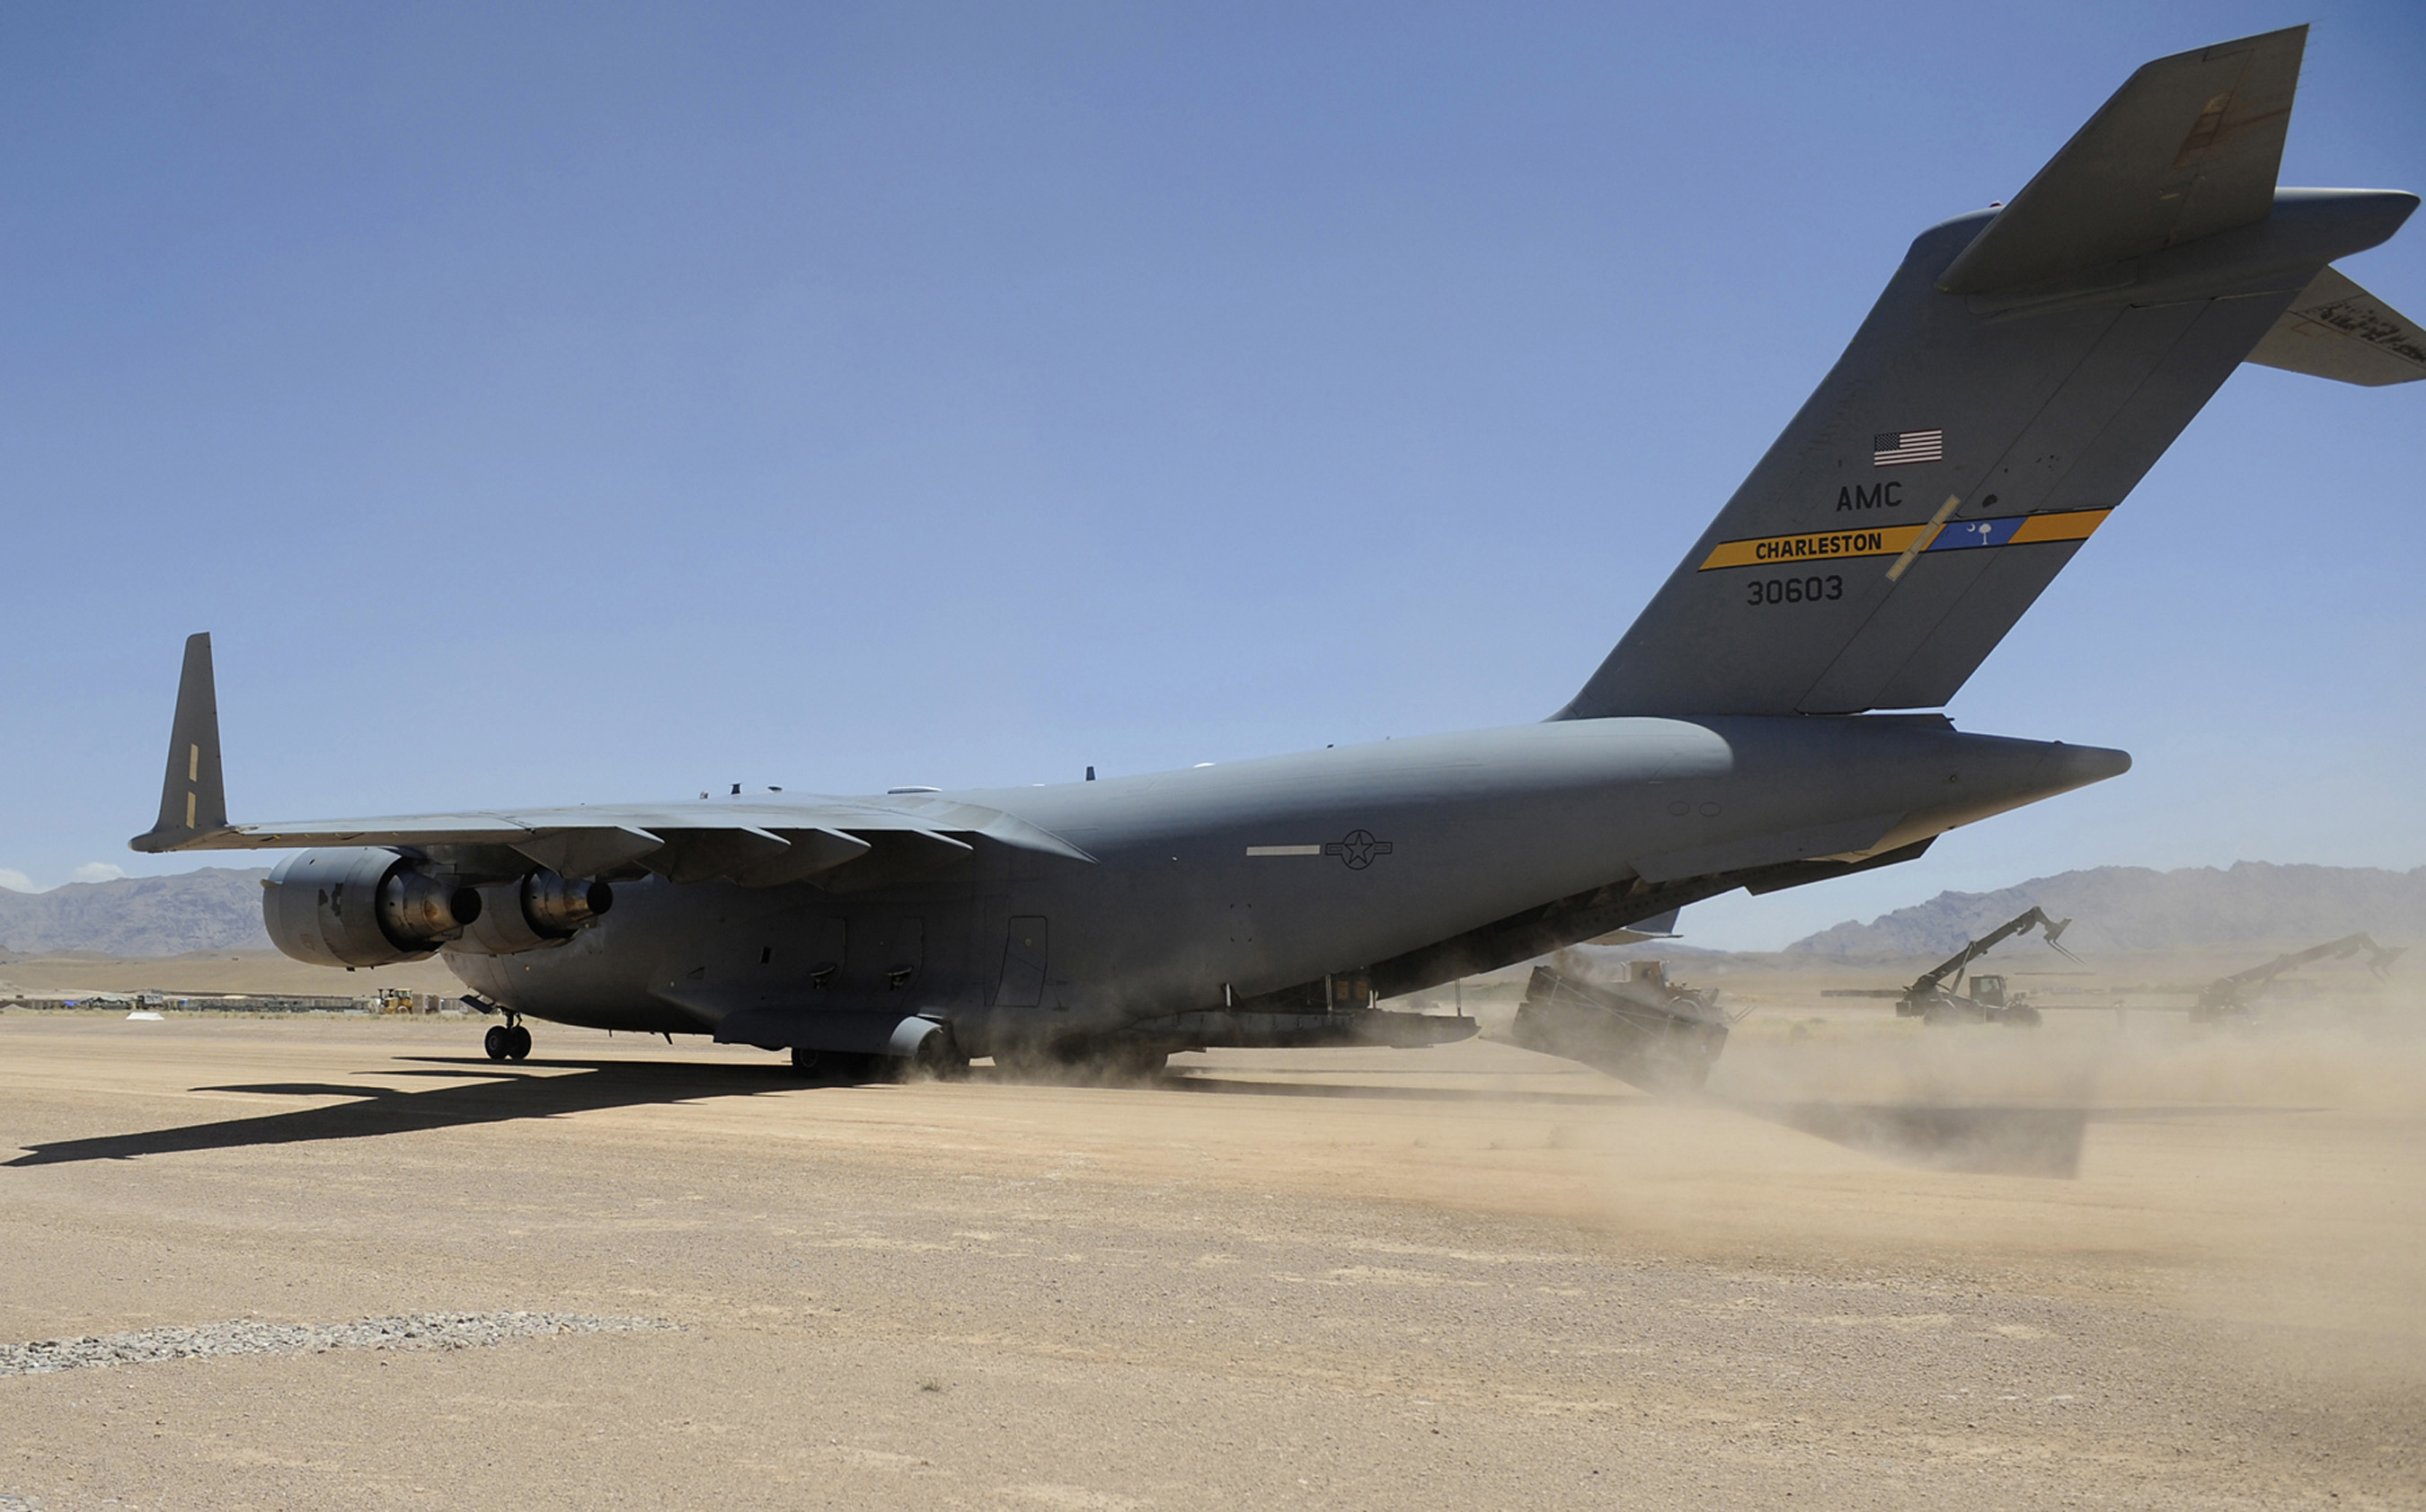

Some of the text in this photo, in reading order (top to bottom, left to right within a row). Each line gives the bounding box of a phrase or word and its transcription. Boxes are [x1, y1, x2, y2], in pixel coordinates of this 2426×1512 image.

[1836, 482, 1902, 511] AMC
[1756, 533, 1881, 560] CHARLESTON
[1747, 575, 1843, 606] 30603
